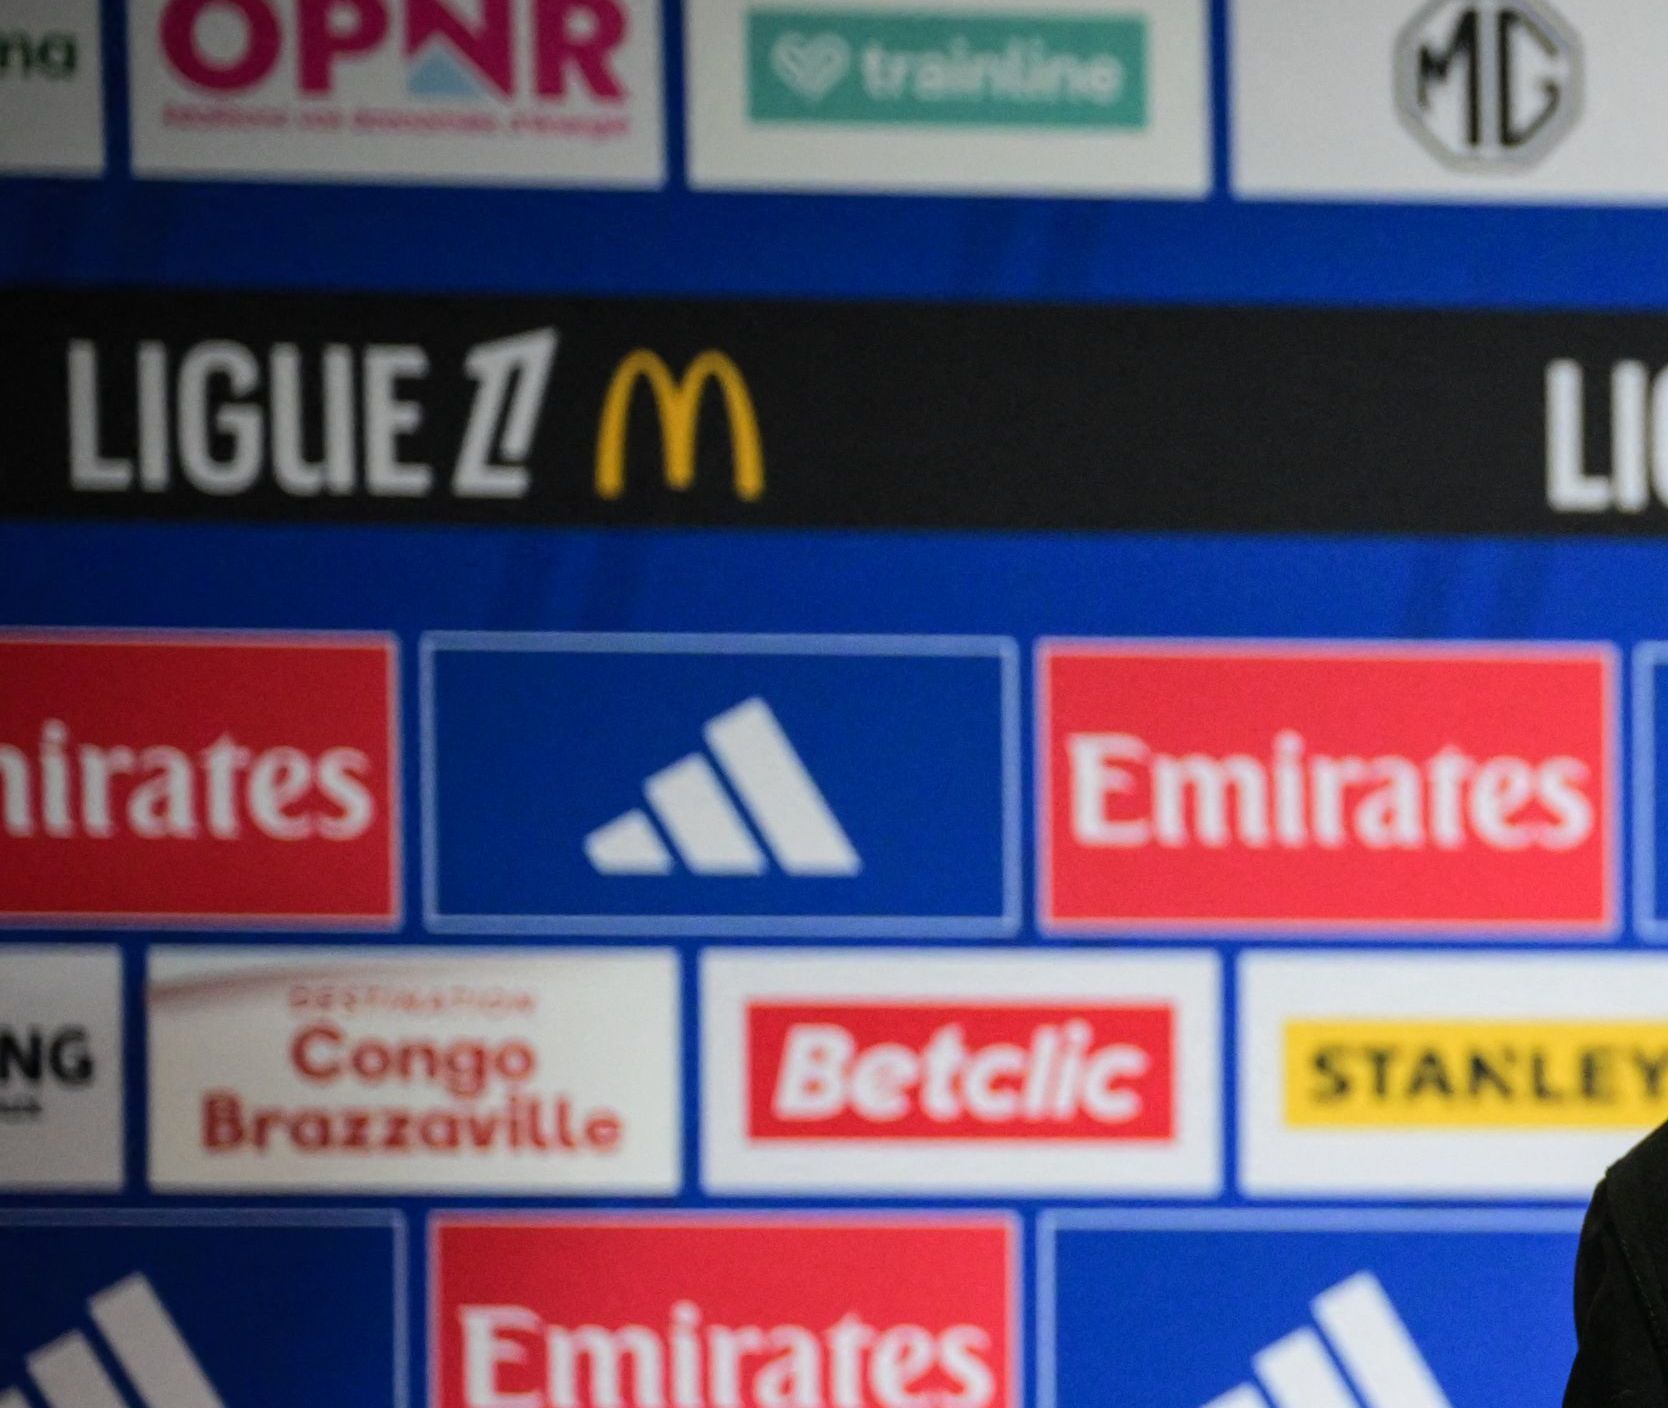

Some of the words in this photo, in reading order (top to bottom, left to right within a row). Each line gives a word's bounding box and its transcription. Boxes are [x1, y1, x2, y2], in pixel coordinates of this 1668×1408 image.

[160, 0, 627, 102] OPNR
[862, 39, 1125, 106] trainline
[1417, 6, 1559, 149] MG
[69, 341, 433, 496] LIGUE
[0, 722, 374, 840] irates
[1069, 732, 1593, 849] Emirates
[288, 1024, 536, 1097] Congo
[775, 1020, 1147, 1122] Betclic
[203, 1092, 625, 1154] Brazzaville
